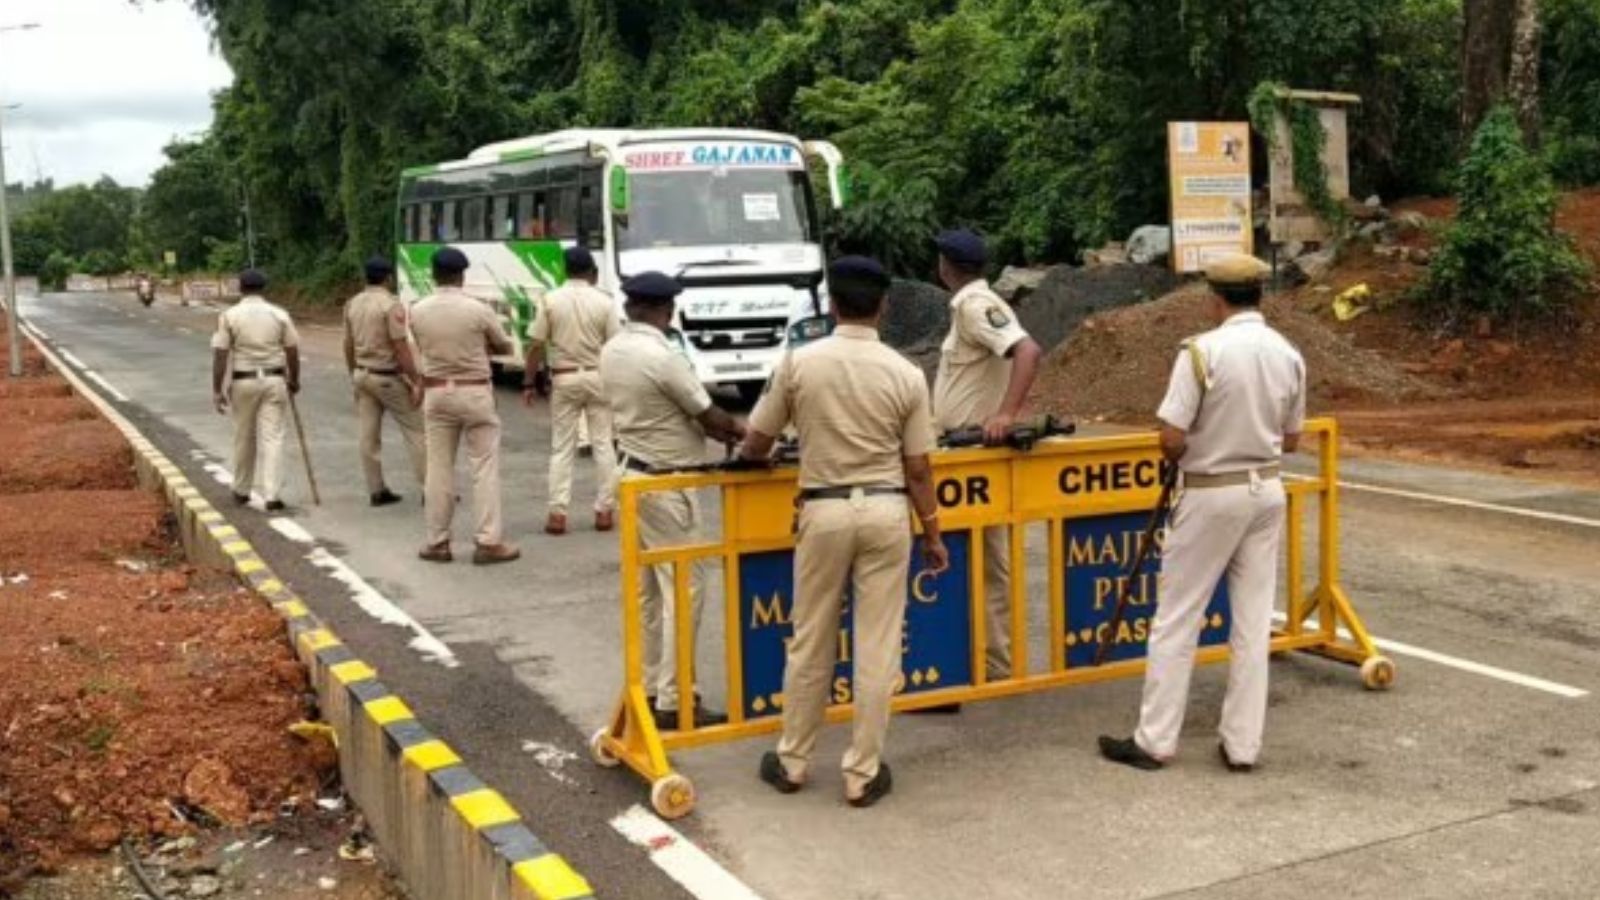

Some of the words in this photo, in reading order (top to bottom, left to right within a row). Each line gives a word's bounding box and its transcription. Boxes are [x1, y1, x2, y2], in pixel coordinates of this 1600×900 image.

[692, 144, 794, 164] GAJANAN
[936, 477, 991, 507] OR
[1067, 528, 1165, 568] MAJES
[1096, 617, 1149, 643] CAS
